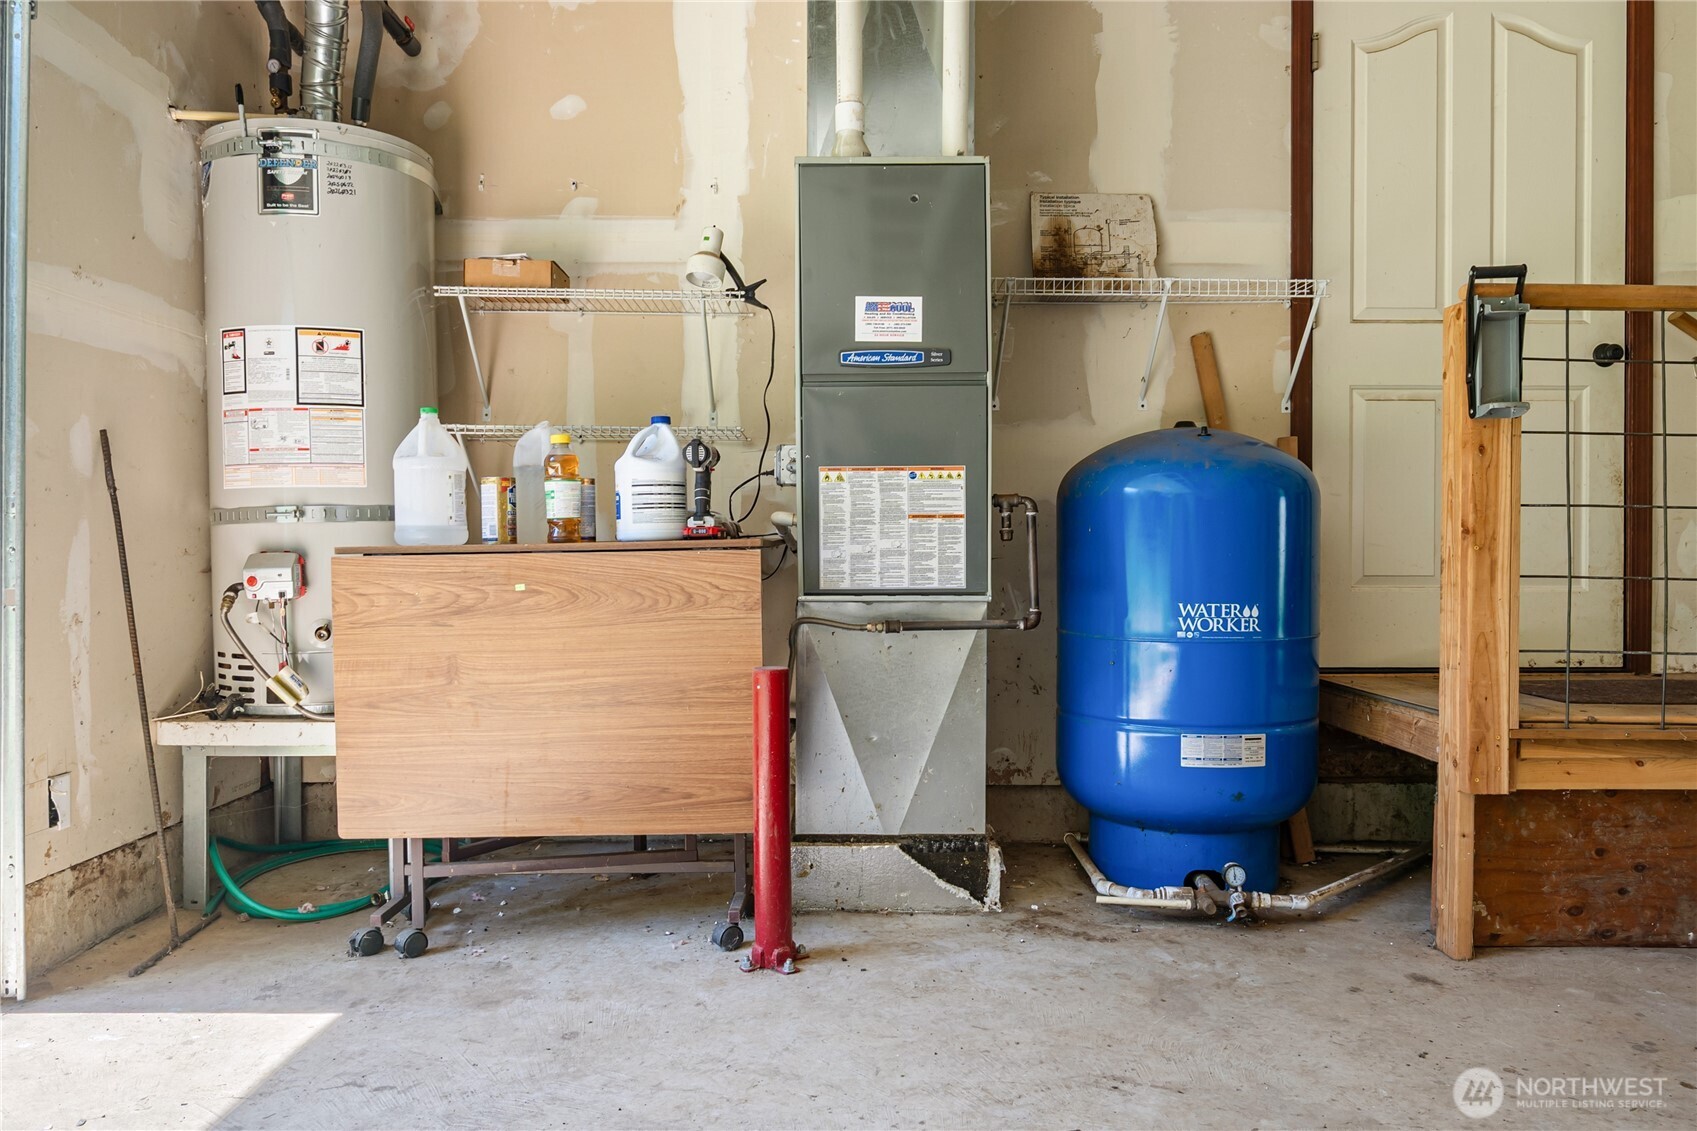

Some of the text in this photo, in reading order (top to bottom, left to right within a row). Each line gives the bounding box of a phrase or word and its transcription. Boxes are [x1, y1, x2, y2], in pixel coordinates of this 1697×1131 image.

[258, 158, 318, 169] DEFENDER
[846, 352, 918, 363] American Standard
[1178, 603, 1243, 618] WATER
[1178, 617, 1261, 632] WORKER
